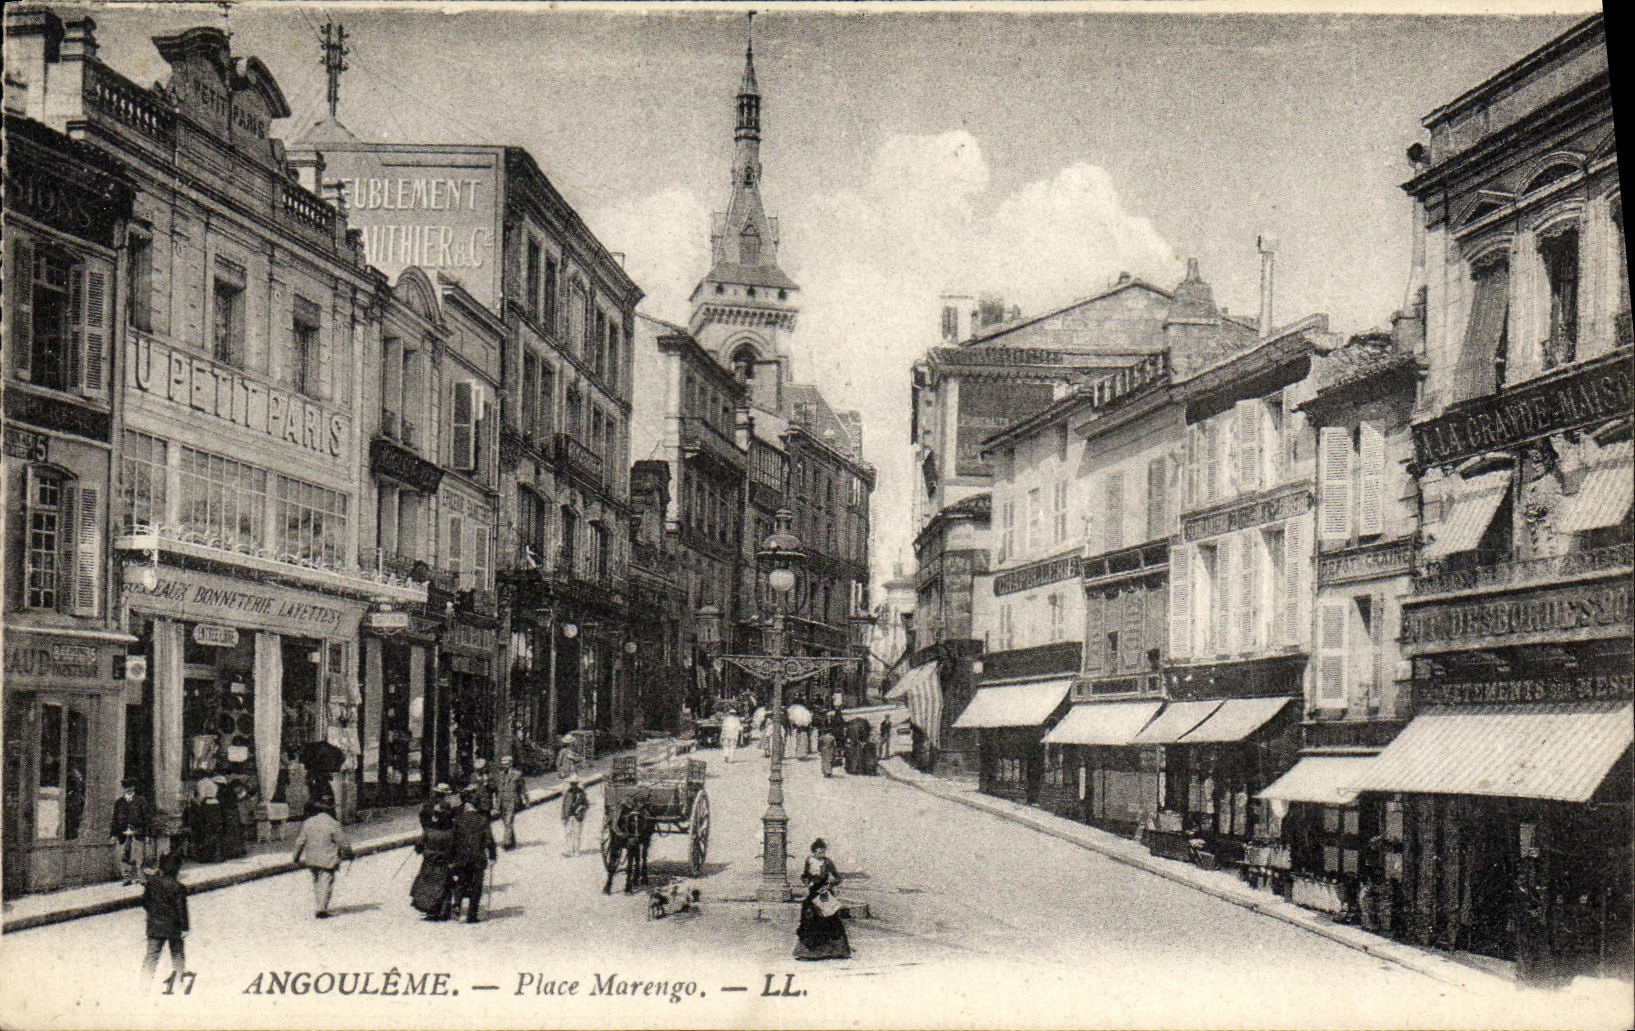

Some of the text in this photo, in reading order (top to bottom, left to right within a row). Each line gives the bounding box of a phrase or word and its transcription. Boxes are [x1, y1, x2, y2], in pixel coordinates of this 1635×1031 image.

[232, 103, 266, 140] PARIS
[323, 177, 481, 212] EUBLEMENT
[348, 225, 455, 269] AUTHIER
[166, 350, 257, 429] PETIT
[266, 388, 349, 458] PARIS
